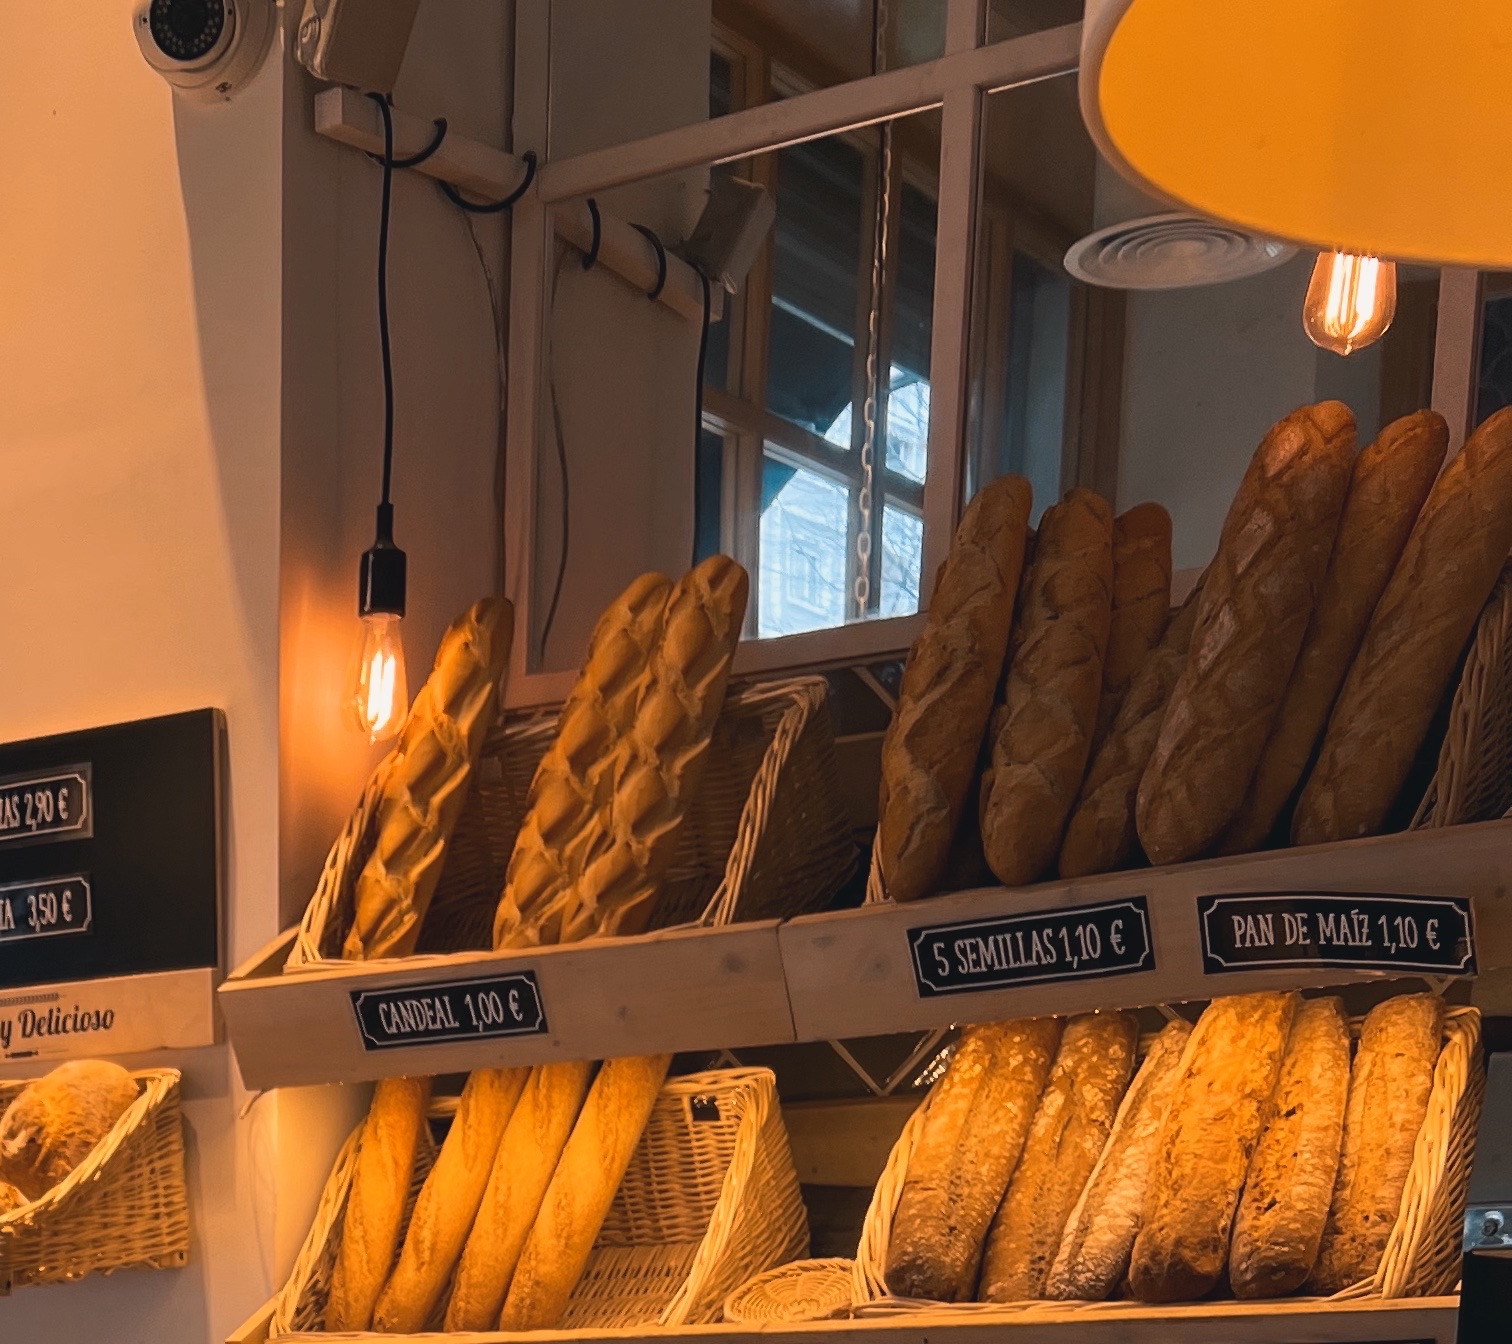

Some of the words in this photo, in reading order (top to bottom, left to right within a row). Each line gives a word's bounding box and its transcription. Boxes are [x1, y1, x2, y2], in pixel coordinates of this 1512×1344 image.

[24, 790, 54, 831] 2,90
[58, 787, 68, 820] €
[27, 892, 57, 932] 3,50
[62, 888, 72, 922] €
[1232, 913, 1274, 947] PAN
[1282, 912, 1310, 945] DE
[1316, 908, 1372, 946] MAÍZ
[1378, 915, 1418, 953] 1,10
[1426, 918, 1441, 950] €
[933, 942, 950, 977] 5
[954, 928, 1057, 974] SEMILLAS
[1059, 923, 1101, 969] 1,10
[1110, 919, 1126, 955] €
[0, 1019, 12, 1049] y
[18, 1004, 115, 1039] Delicioso
[378, 996, 459, 1034] CANDEAL
[464, 991, 504, 1032] 1,00
[508, 988, 523, 1021] €
